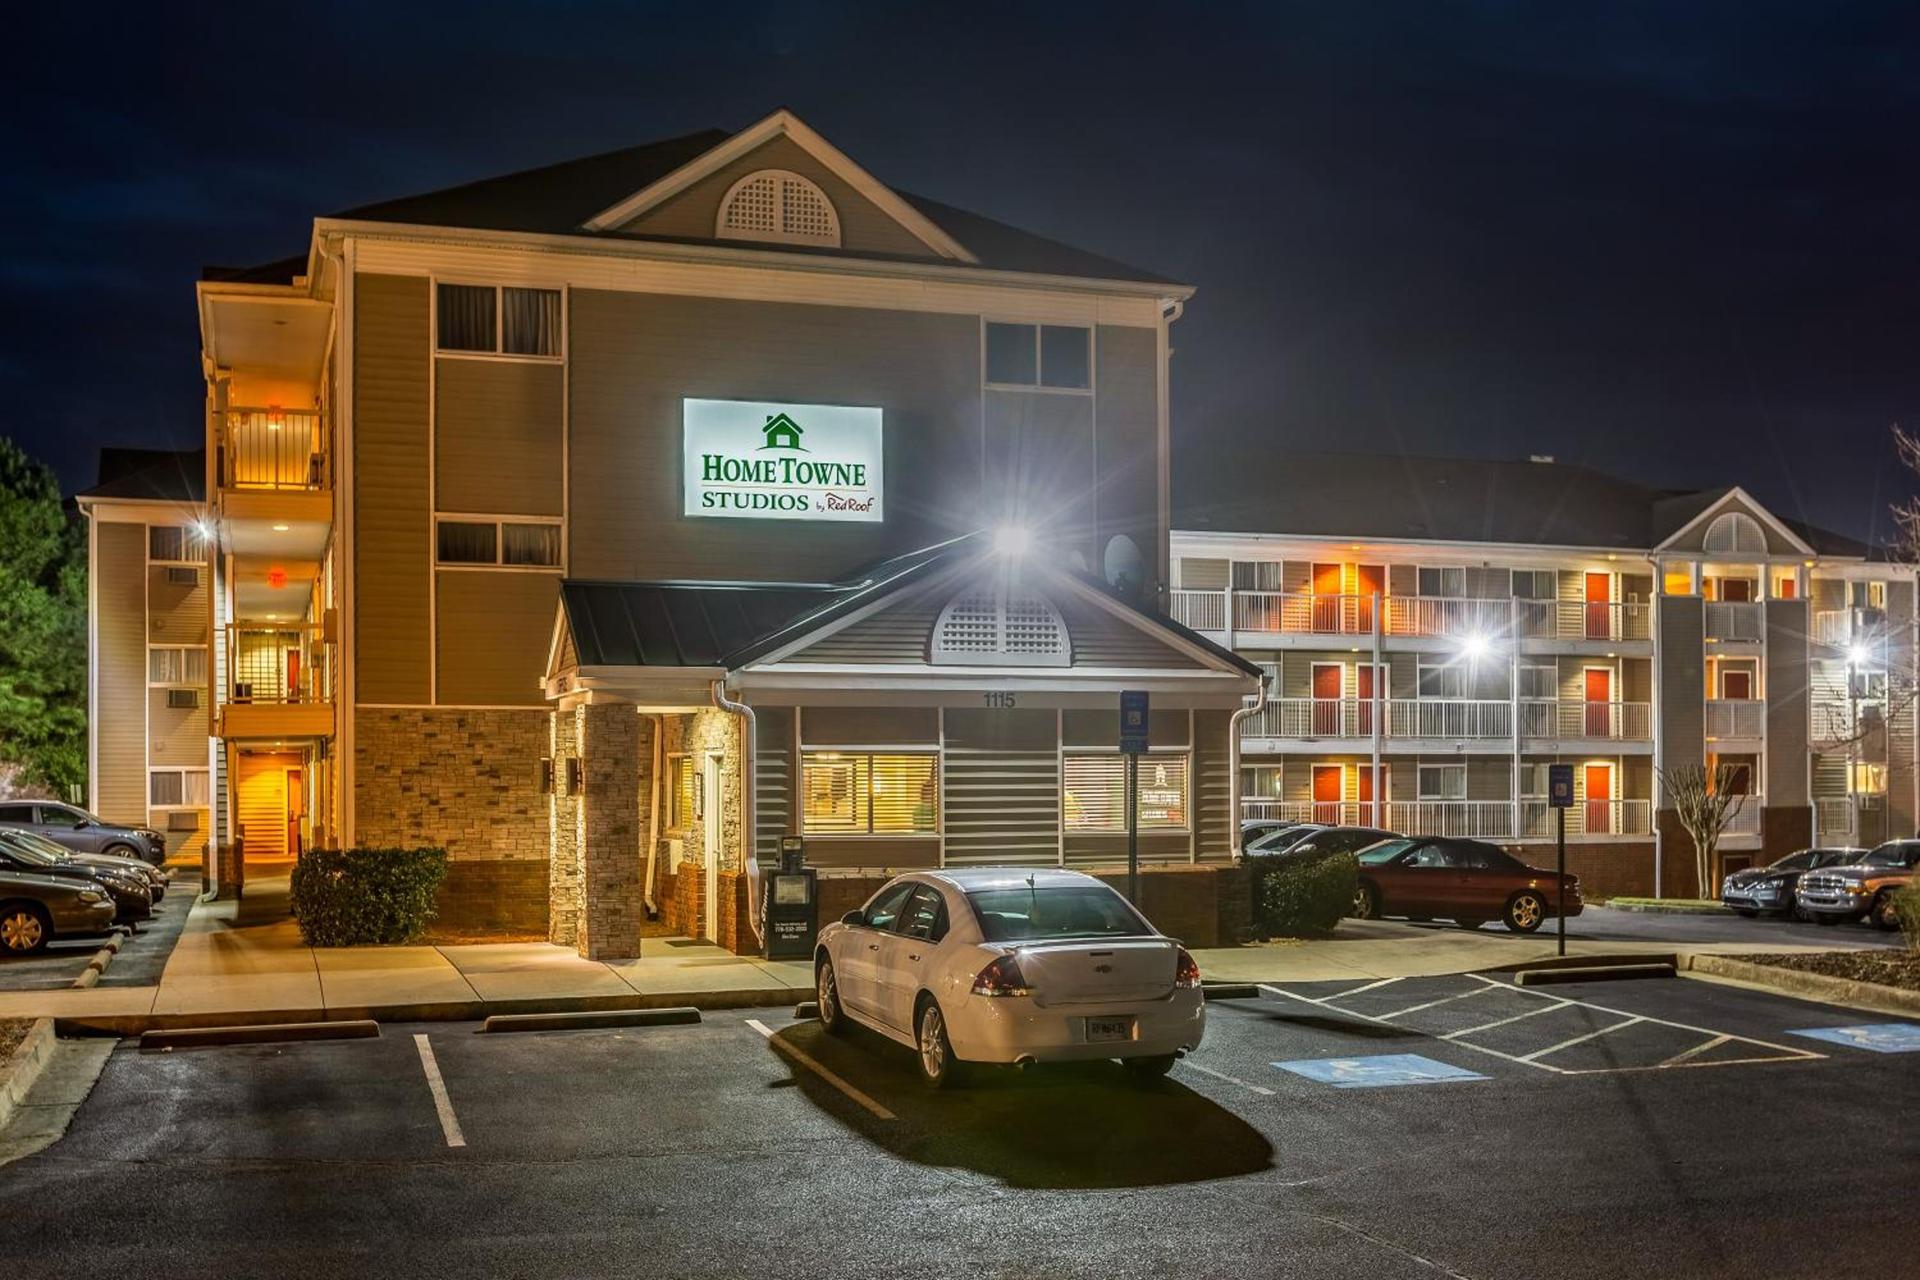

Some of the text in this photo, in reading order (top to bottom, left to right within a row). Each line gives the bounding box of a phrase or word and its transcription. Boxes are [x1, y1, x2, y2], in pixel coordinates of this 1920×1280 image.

[702, 491, 809, 511] STUDIOS
[815, 501, 826, 513] by
[984, 691, 1016, 708] 1115
